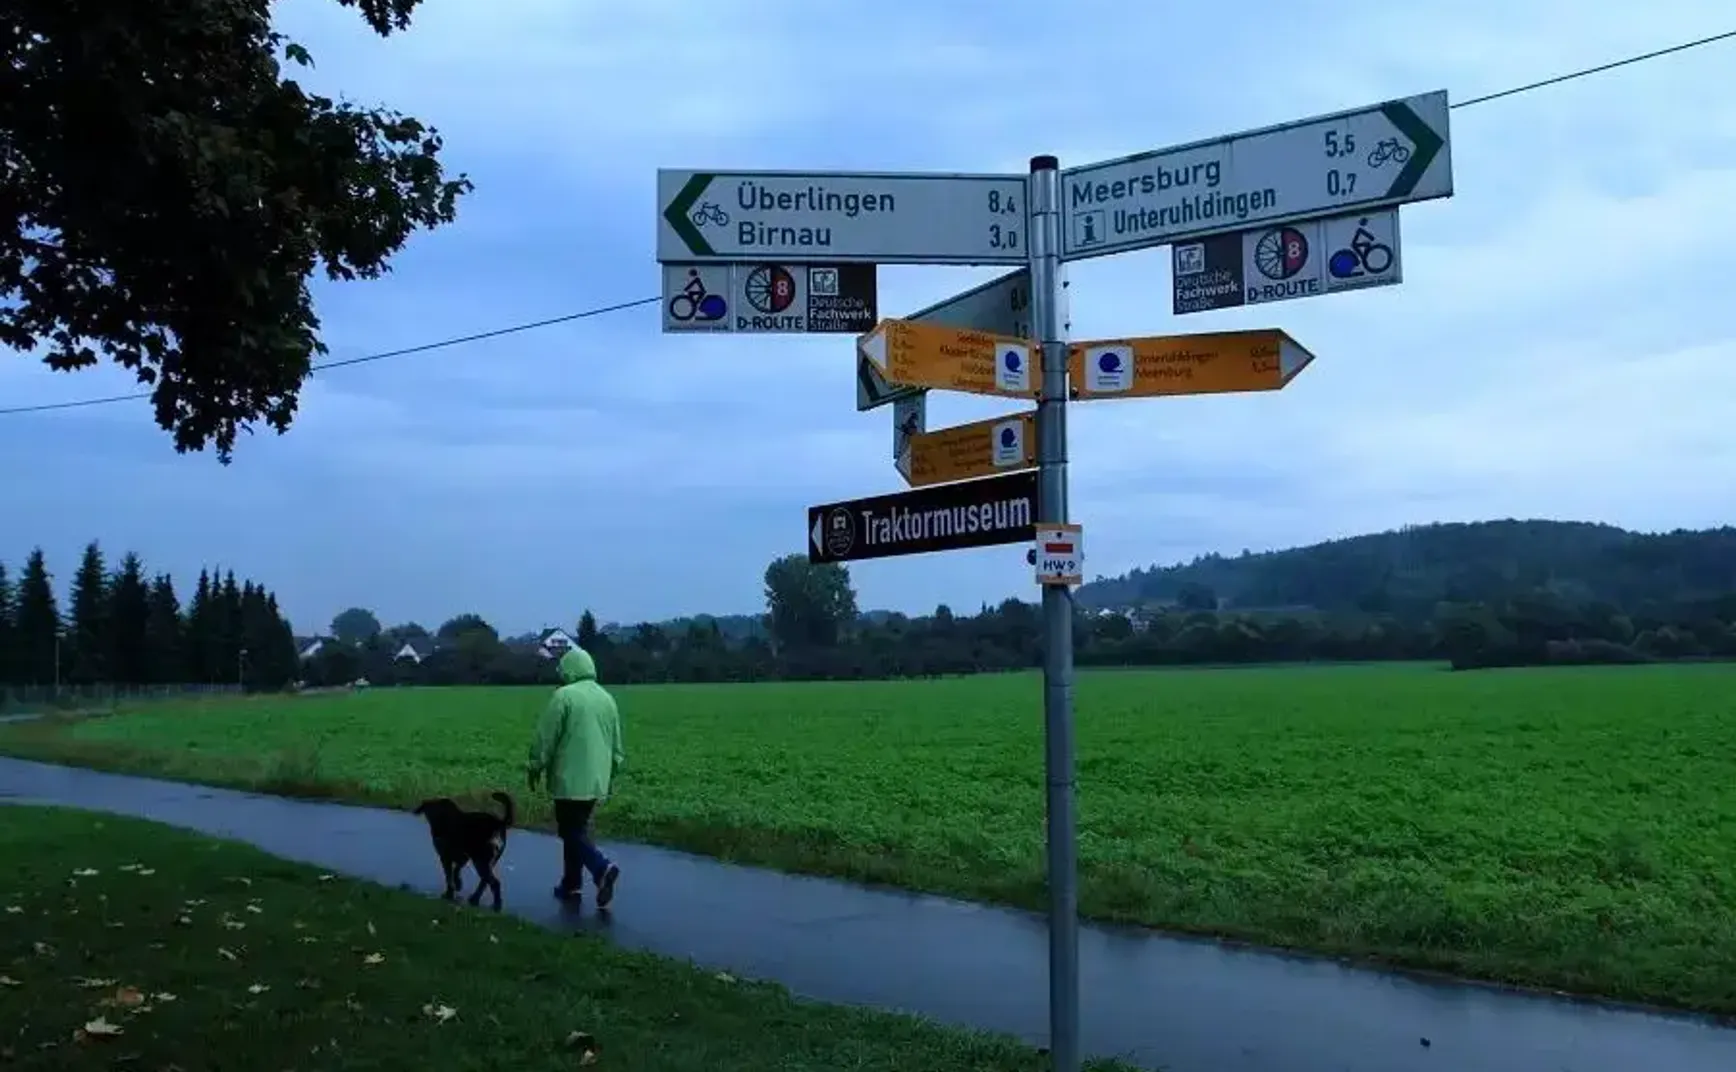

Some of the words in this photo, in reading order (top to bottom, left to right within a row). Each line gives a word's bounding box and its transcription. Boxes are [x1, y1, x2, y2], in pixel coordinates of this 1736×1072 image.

[1072, 160, 1221, 207] Meersburg
[738, 181, 895, 217] Überlingen
[988, 190, 1015, 215] 8,4
[1114, 187, 1276, 235] Unteruhldingen
[738, 221, 831, 247] Birnau
[989, 224, 1017, 250] 3,0
[1288, 241, 1300, 259] 8
[776, 280, 789, 297] 8
[1176, 280, 1239, 300] Fachwerk
[1248, 278, 1319, 301] D-ROUTE
[737, 315, 804, 330] D-ROUTE
[810, 307, 871, 320] Fachwerk
[862, 497, 1031, 546] Traktormuseum
